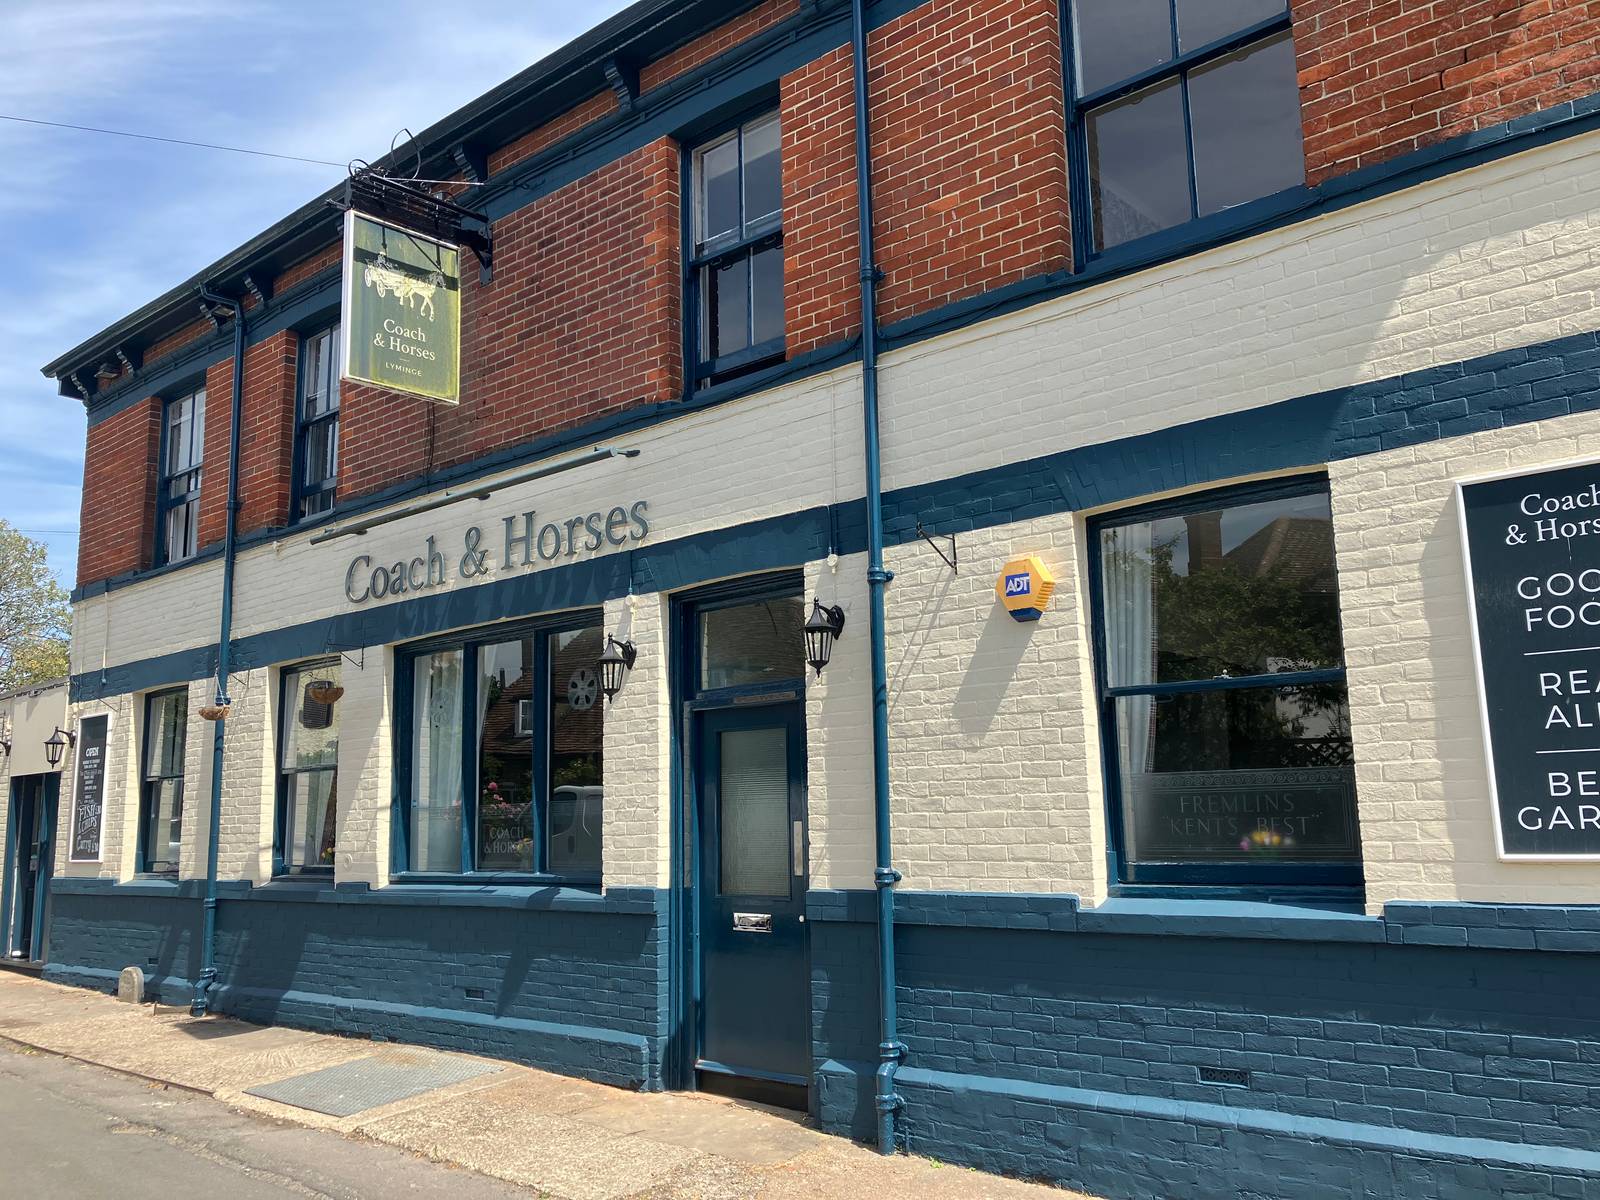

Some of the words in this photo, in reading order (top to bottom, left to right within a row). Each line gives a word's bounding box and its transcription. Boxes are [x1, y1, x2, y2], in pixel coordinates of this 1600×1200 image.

[383, 319, 426, 343] Coach
[373, 332, 385, 348] &
[389, 336, 436, 361] Horses
[385, 362, 423, 377] LYMINGE
[1505, 524, 1527, 546] &
[345, 535, 446, 603] Coach
[459, 526, 489, 579] &
[501, 500, 649, 570] Horses
[1006, 576, 1030, 593] ADT
[1539, 669, 1600, 697] RE
[1545, 702, 1600, 729] AL
[1180, 792, 1295, 814] FREMLINS
[489, 826, 524, 840] COACH
